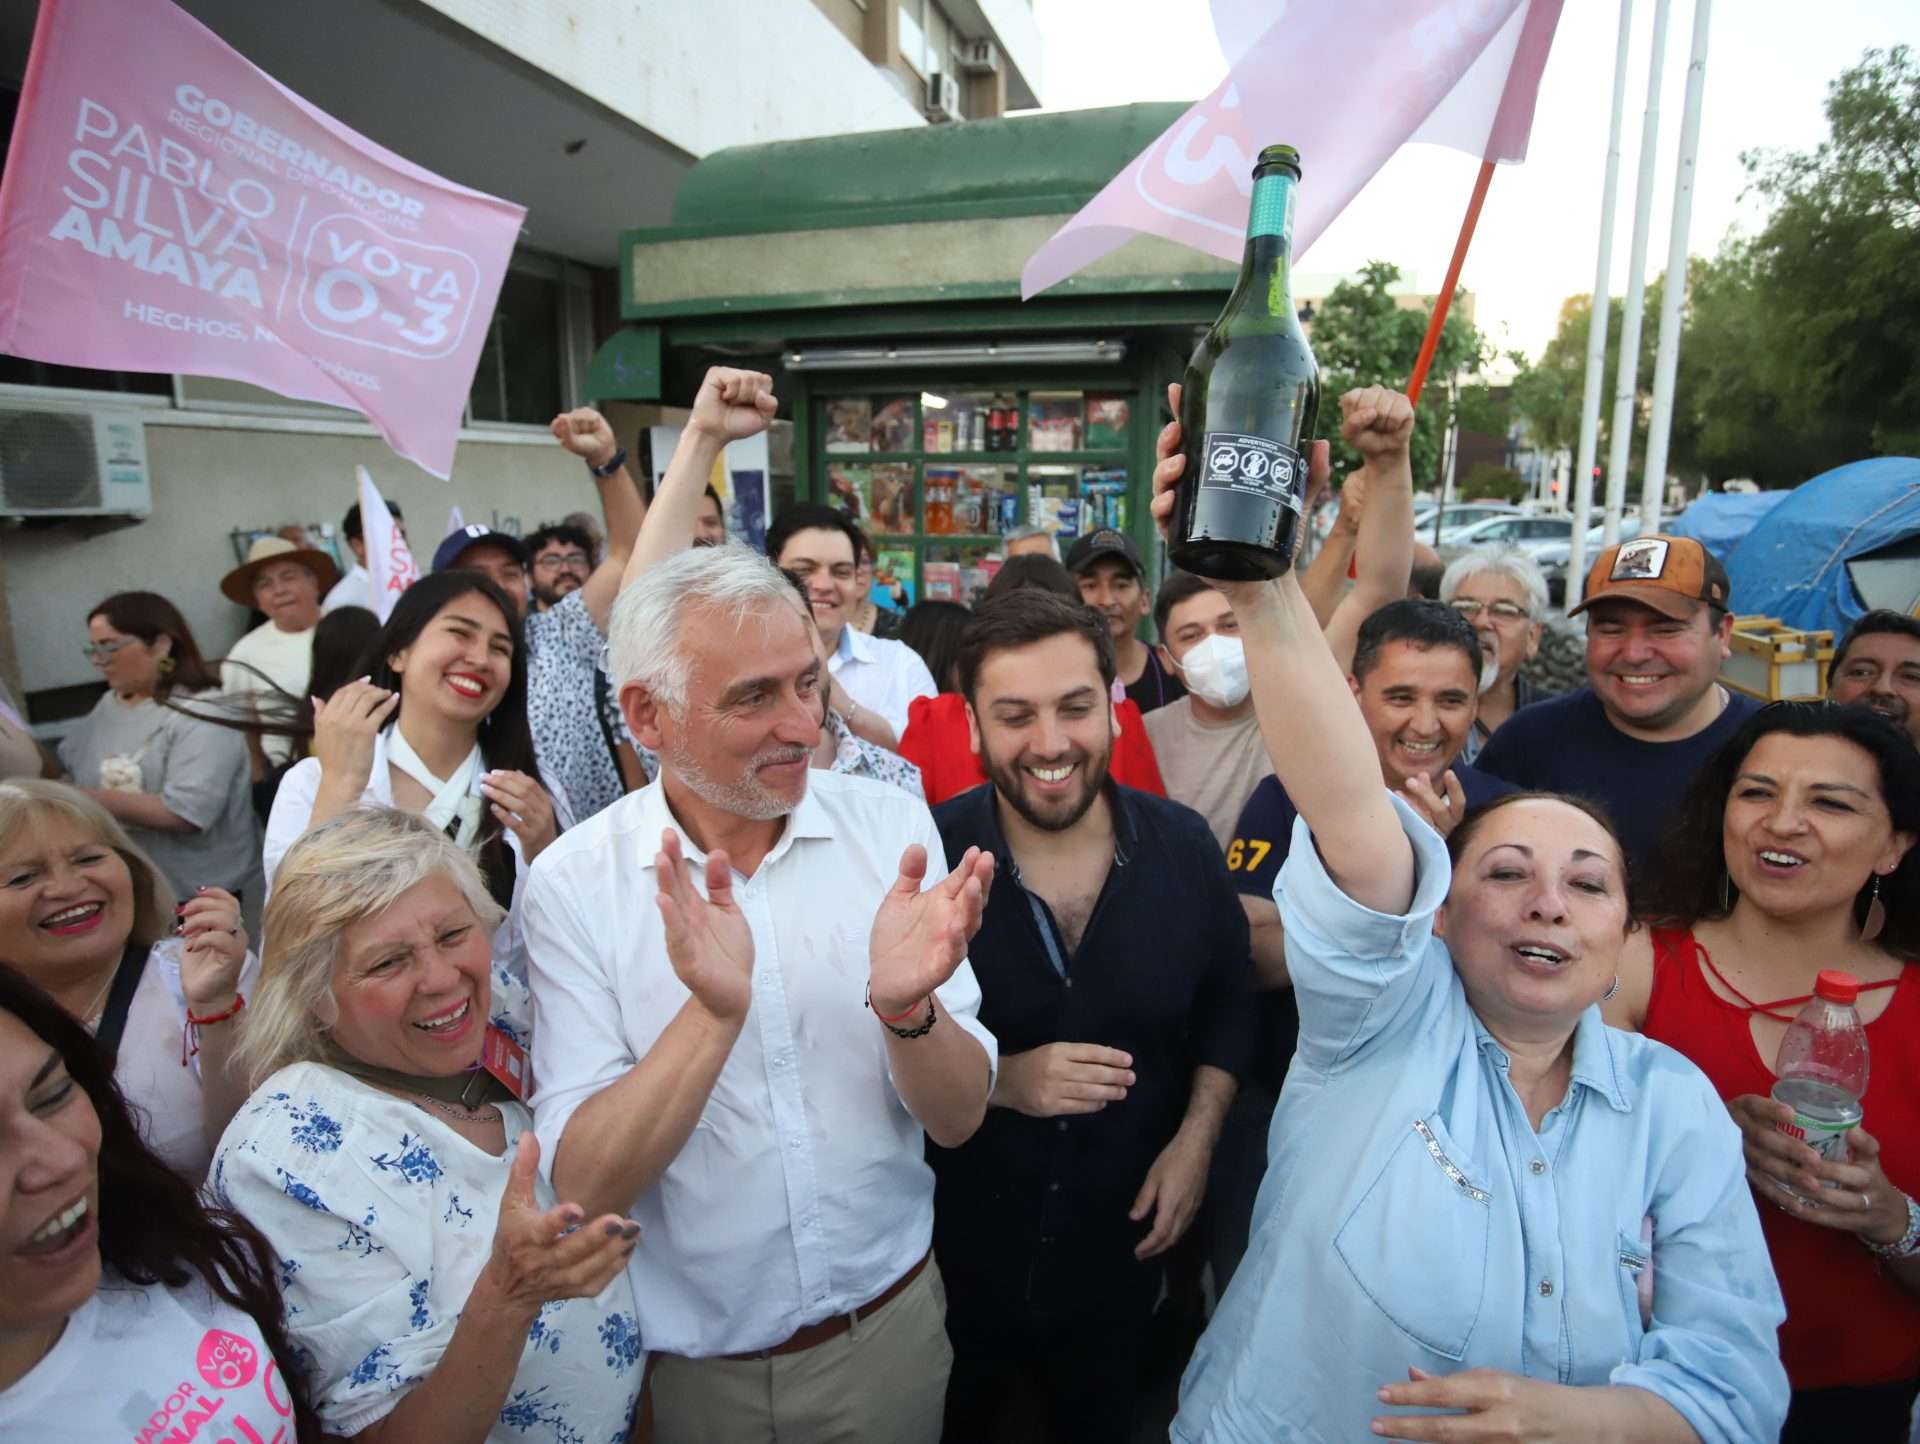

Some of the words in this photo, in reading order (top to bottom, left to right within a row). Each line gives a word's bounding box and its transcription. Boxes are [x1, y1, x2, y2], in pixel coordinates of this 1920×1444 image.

[75, 97, 275, 219] PABLO
[175, 83, 425, 219] GOBERNADOR
[48, 205, 264, 309] AMAYA
[63, 148, 268, 270] SILVA
[328, 231, 460, 300] VOTA
[1227, 838, 1271, 871] 67
[202, 1335, 233, 1372] VOTA
